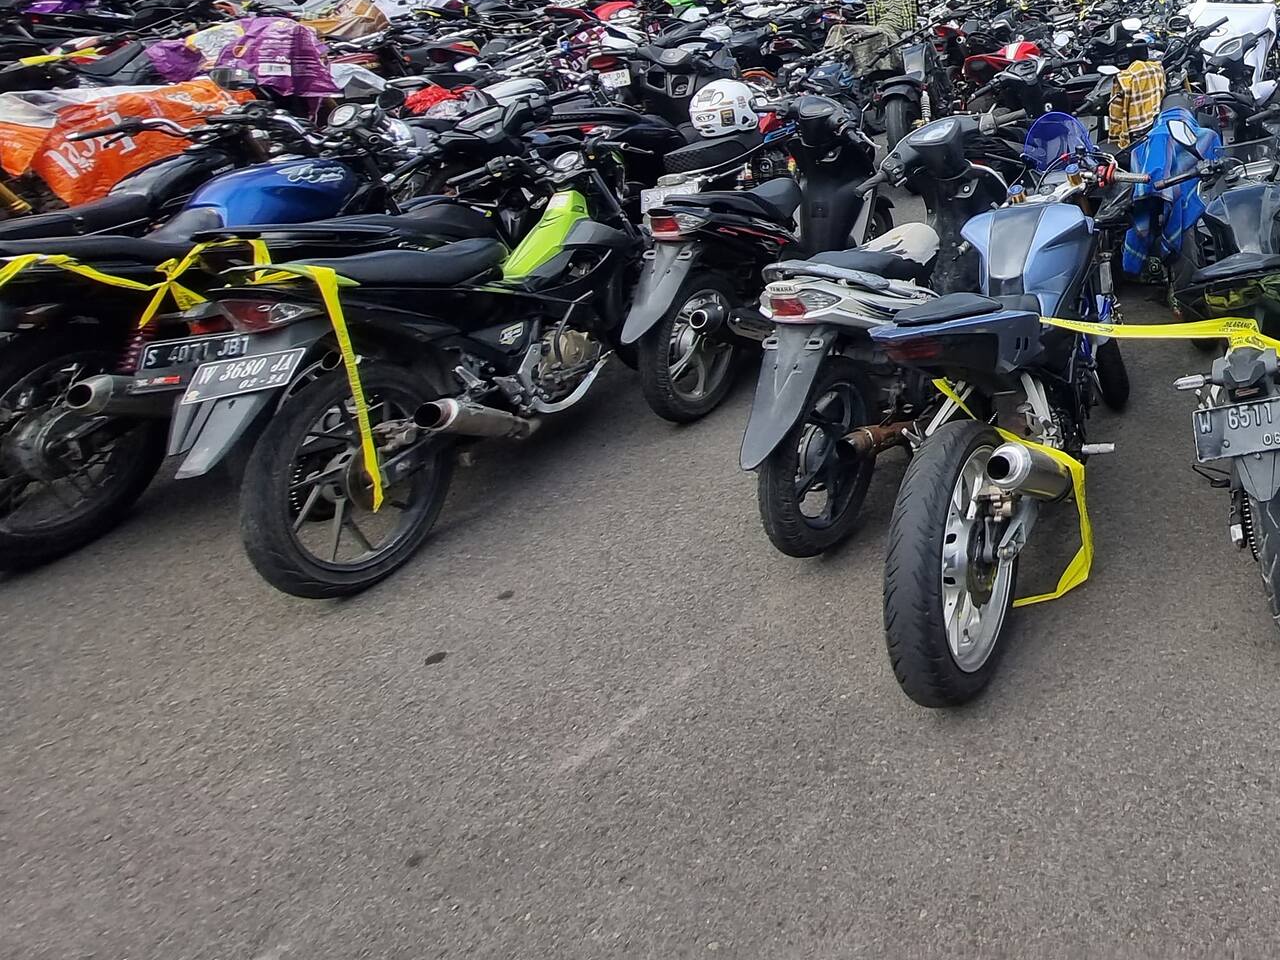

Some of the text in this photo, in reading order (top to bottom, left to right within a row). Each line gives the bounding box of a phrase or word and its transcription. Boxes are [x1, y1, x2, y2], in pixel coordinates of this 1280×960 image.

[696, 114, 715, 122] KYT
[769, 285, 793, 293] YAMAHA
[146, 349, 158, 366] S
[198, 366, 217, 385] W
[219, 357, 268, 382] 3680
[270, 353, 295, 373] JA
[1198, 411, 1212, 434] W
[1228, 402, 1273, 430] 6511
